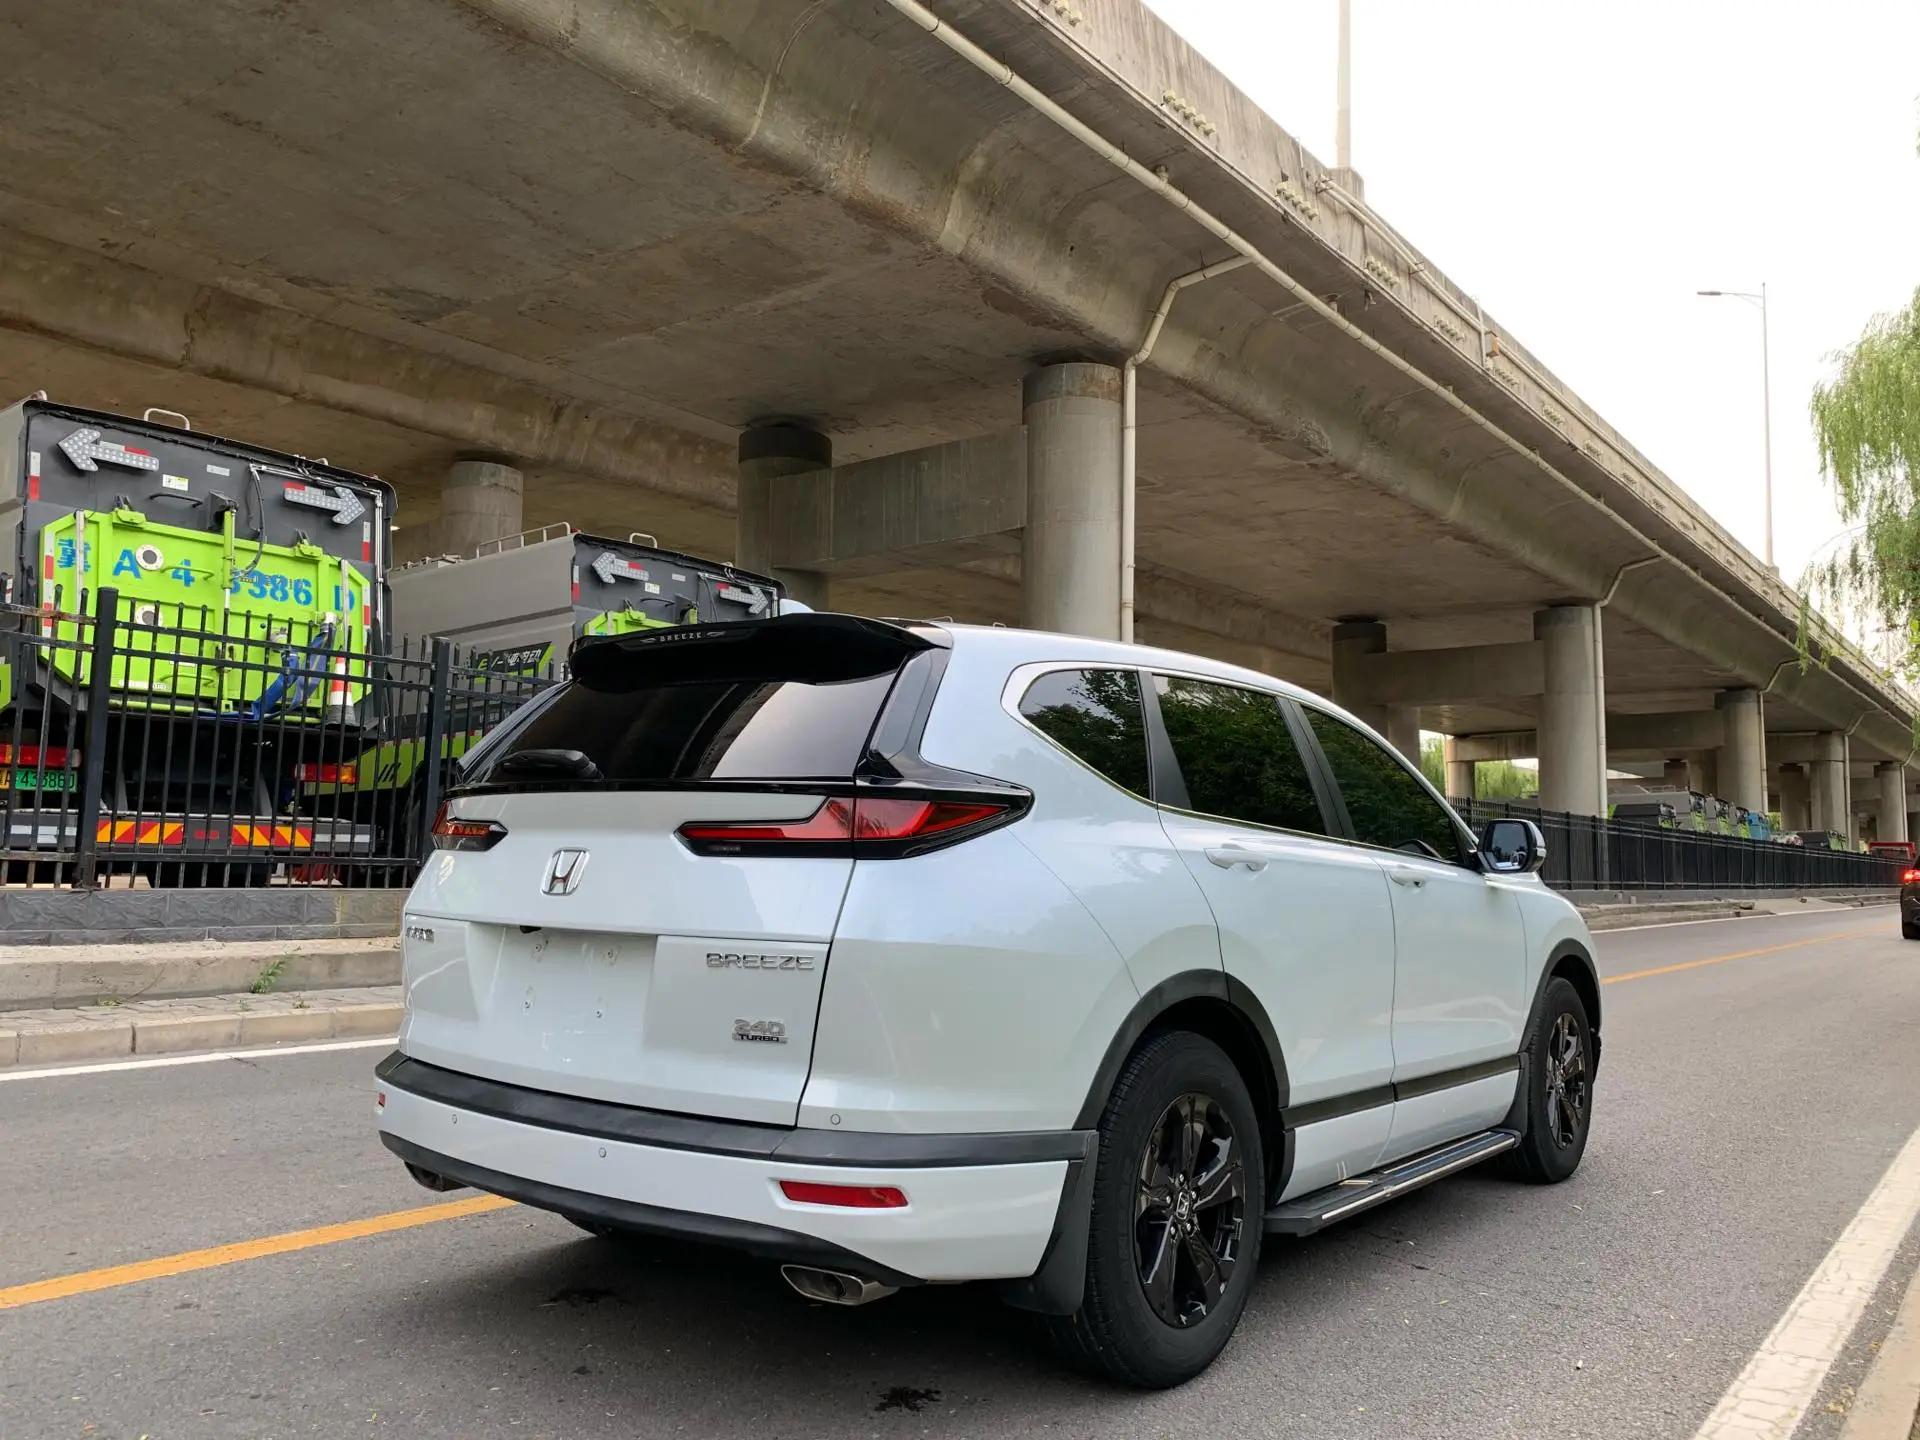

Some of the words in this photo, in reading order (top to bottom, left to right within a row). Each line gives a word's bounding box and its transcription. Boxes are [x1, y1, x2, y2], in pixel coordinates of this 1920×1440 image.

[660, 632, 702, 642] BREEZE
[706, 952, 815, 971] BREEZE
[733, 1018, 786, 1037] 240
[737, 1032, 780, 1043] TURBO
